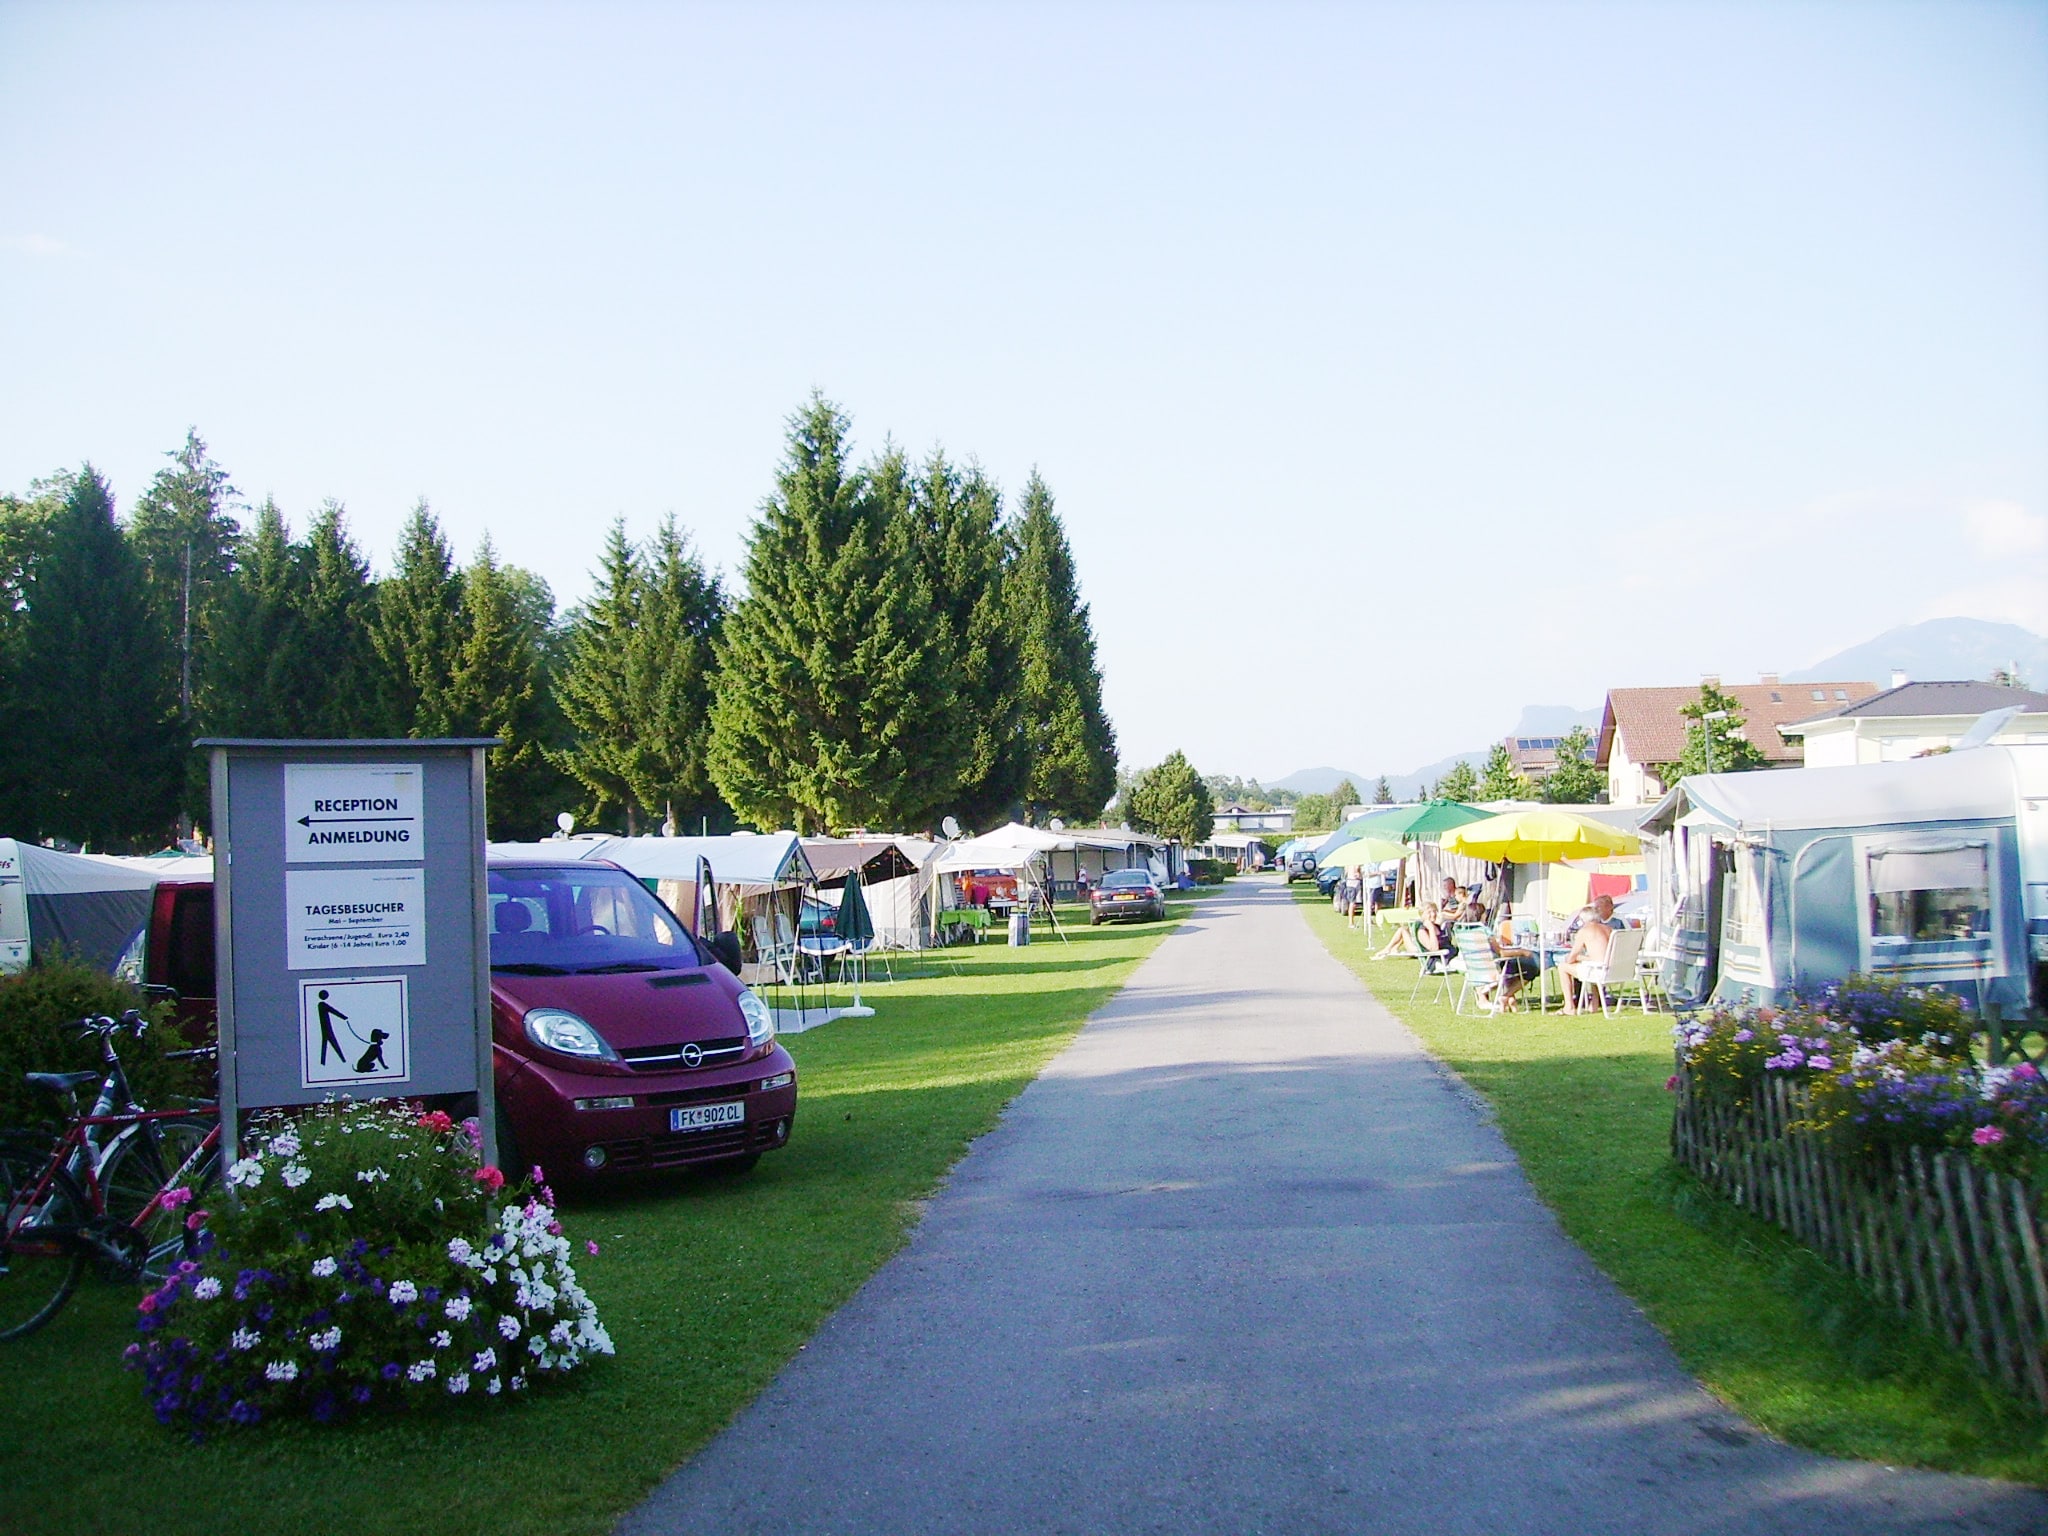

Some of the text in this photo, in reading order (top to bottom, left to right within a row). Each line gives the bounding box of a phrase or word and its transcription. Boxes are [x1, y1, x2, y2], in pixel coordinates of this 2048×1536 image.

[314, 798, 398, 812] RECEPTION
[308, 830, 410, 845] ANMELDUNG
[305, 902, 405, 915] TAGESBESUCHER
[348, 917, 383, 925] September
[681, 1105, 740, 1126] FK 902 CL
